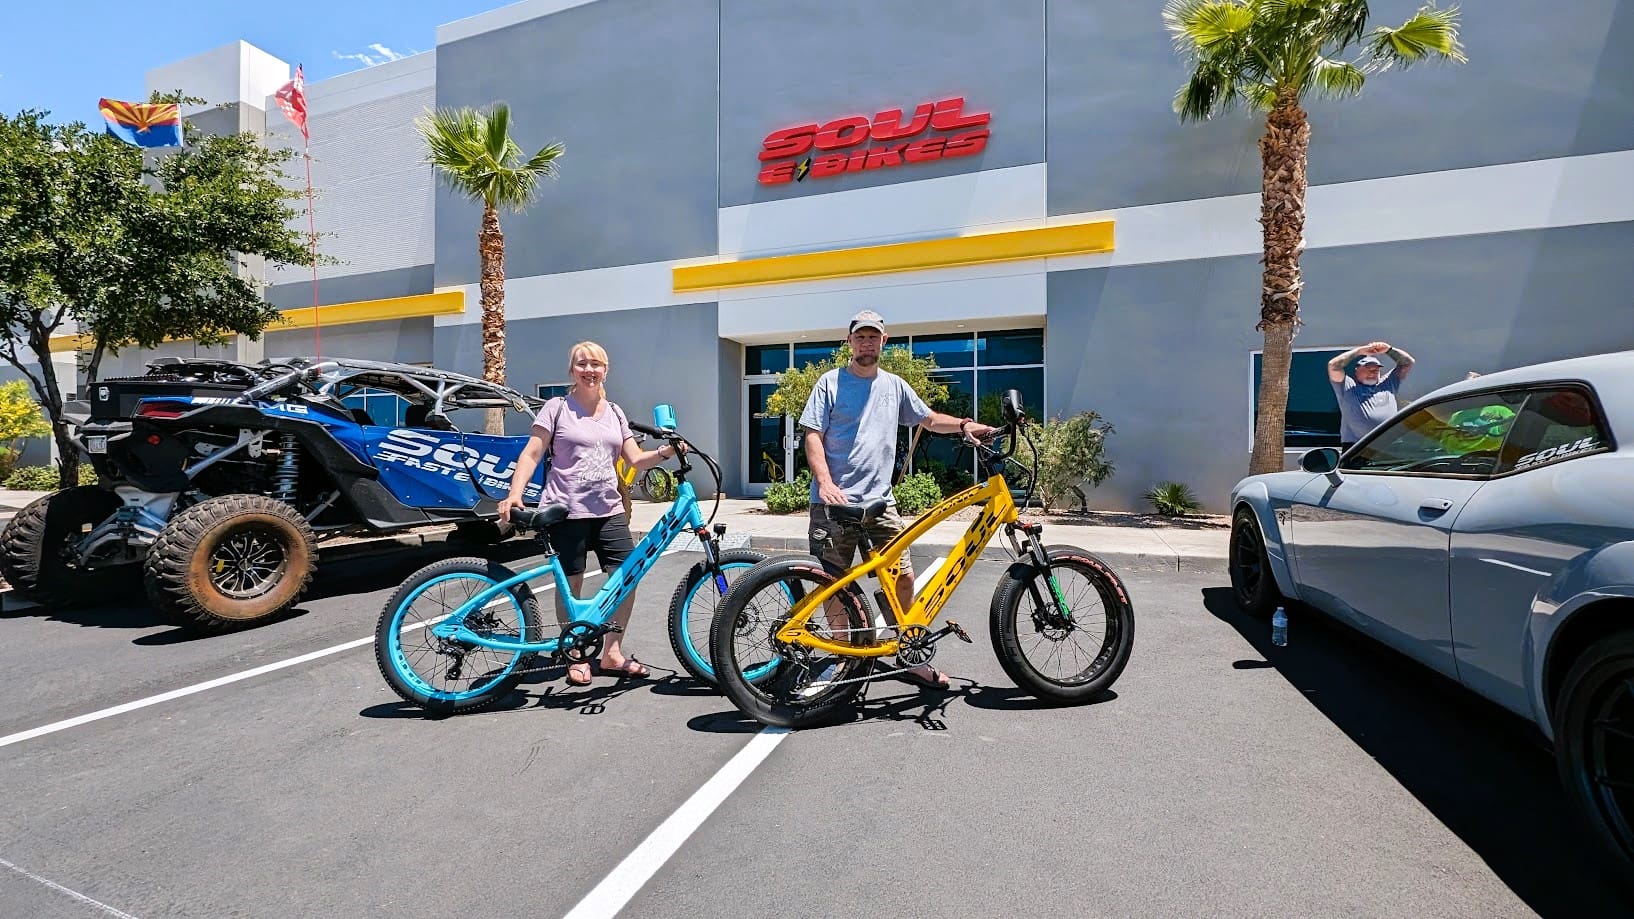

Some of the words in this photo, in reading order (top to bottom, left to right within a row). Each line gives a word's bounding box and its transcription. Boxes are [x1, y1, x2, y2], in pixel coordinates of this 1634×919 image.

[758, 97, 991, 161] SOUL
[1514, 436, 1601, 468] SOUL
[598, 508, 692, 618] SOUL
[924, 503, 1007, 618] SOUL
